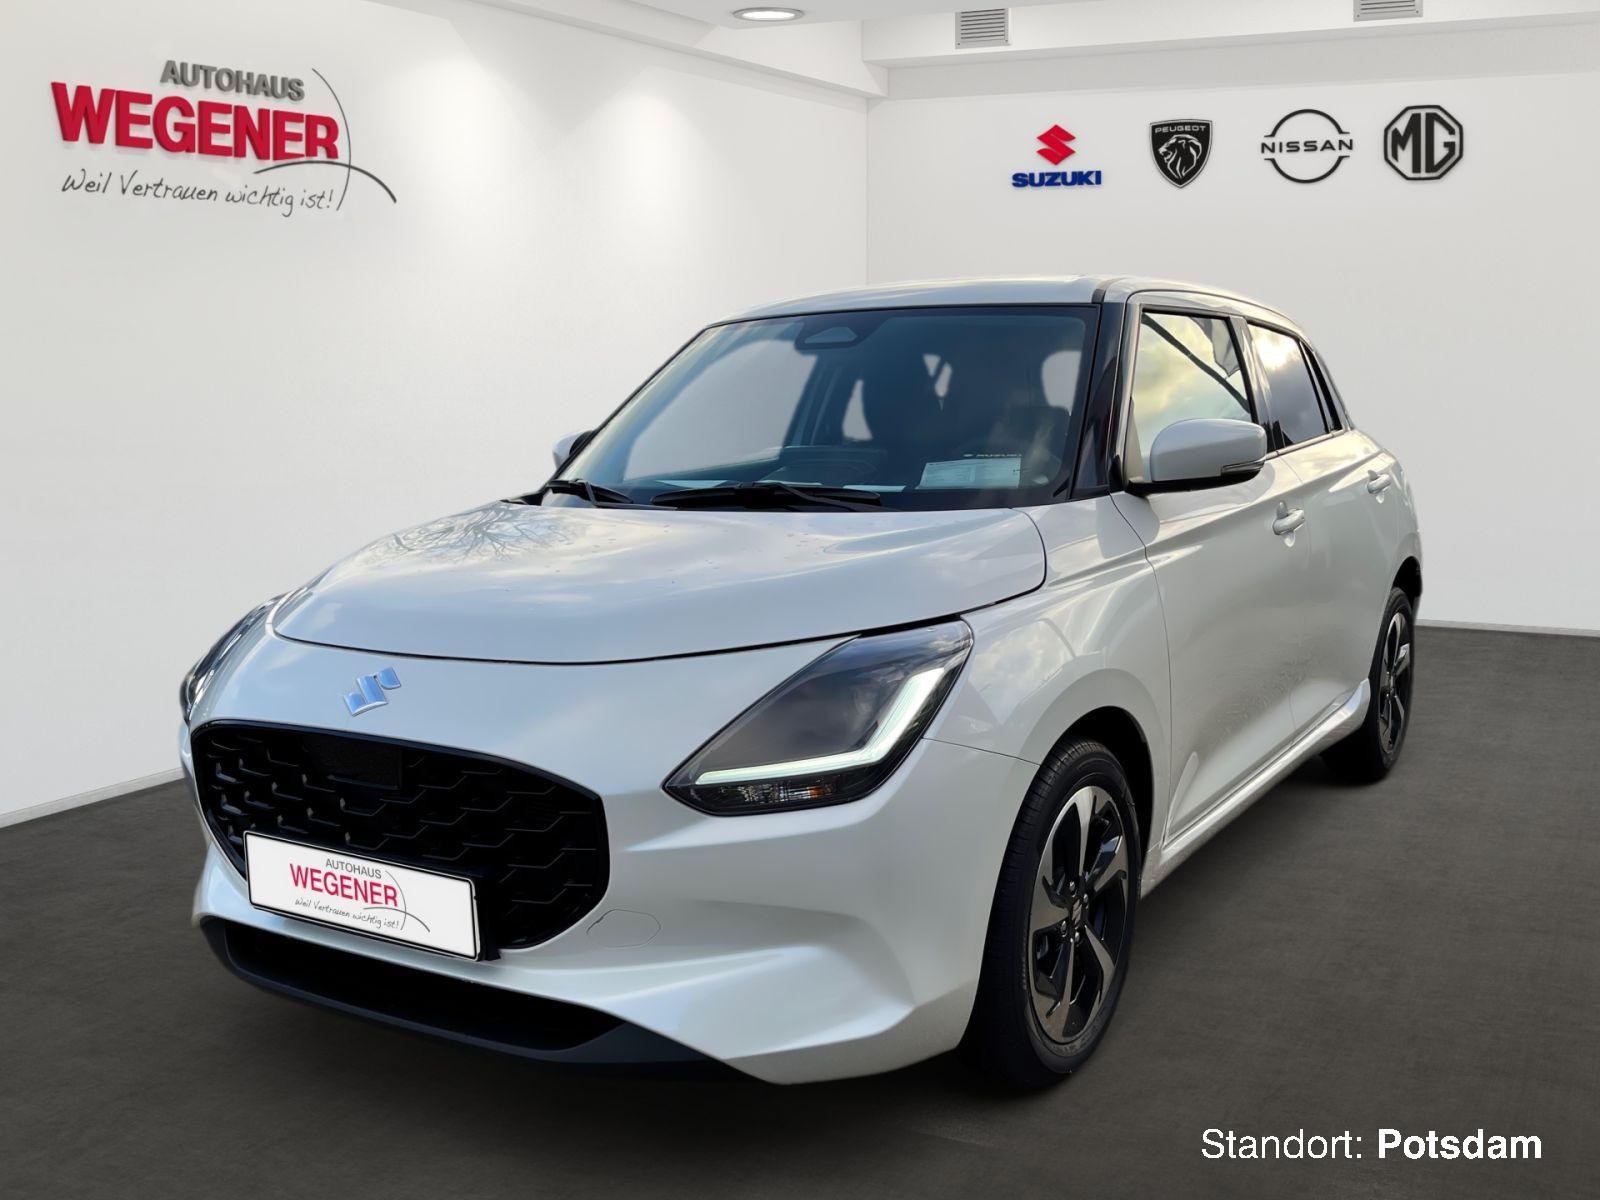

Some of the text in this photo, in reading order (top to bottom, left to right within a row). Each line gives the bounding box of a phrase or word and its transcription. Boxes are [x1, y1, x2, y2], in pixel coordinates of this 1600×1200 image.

[160, 60, 305, 100] AUTOHAUS
[51, 82, 340, 161] WEGENER
[1154, 125, 1206, 133] PEUGEOT
[1261, 138, 1353, 154] NISSAN
[1390, 112, 1457, 174] MG
[61, 168, 334, 218] Weil Vertrauen wichtig ist!
[1012, 170, 1102, 188] SUZUKI
[289, 863, 398, 907] WEGENER
[325, 858, 382, 880] AUTOHAUS
